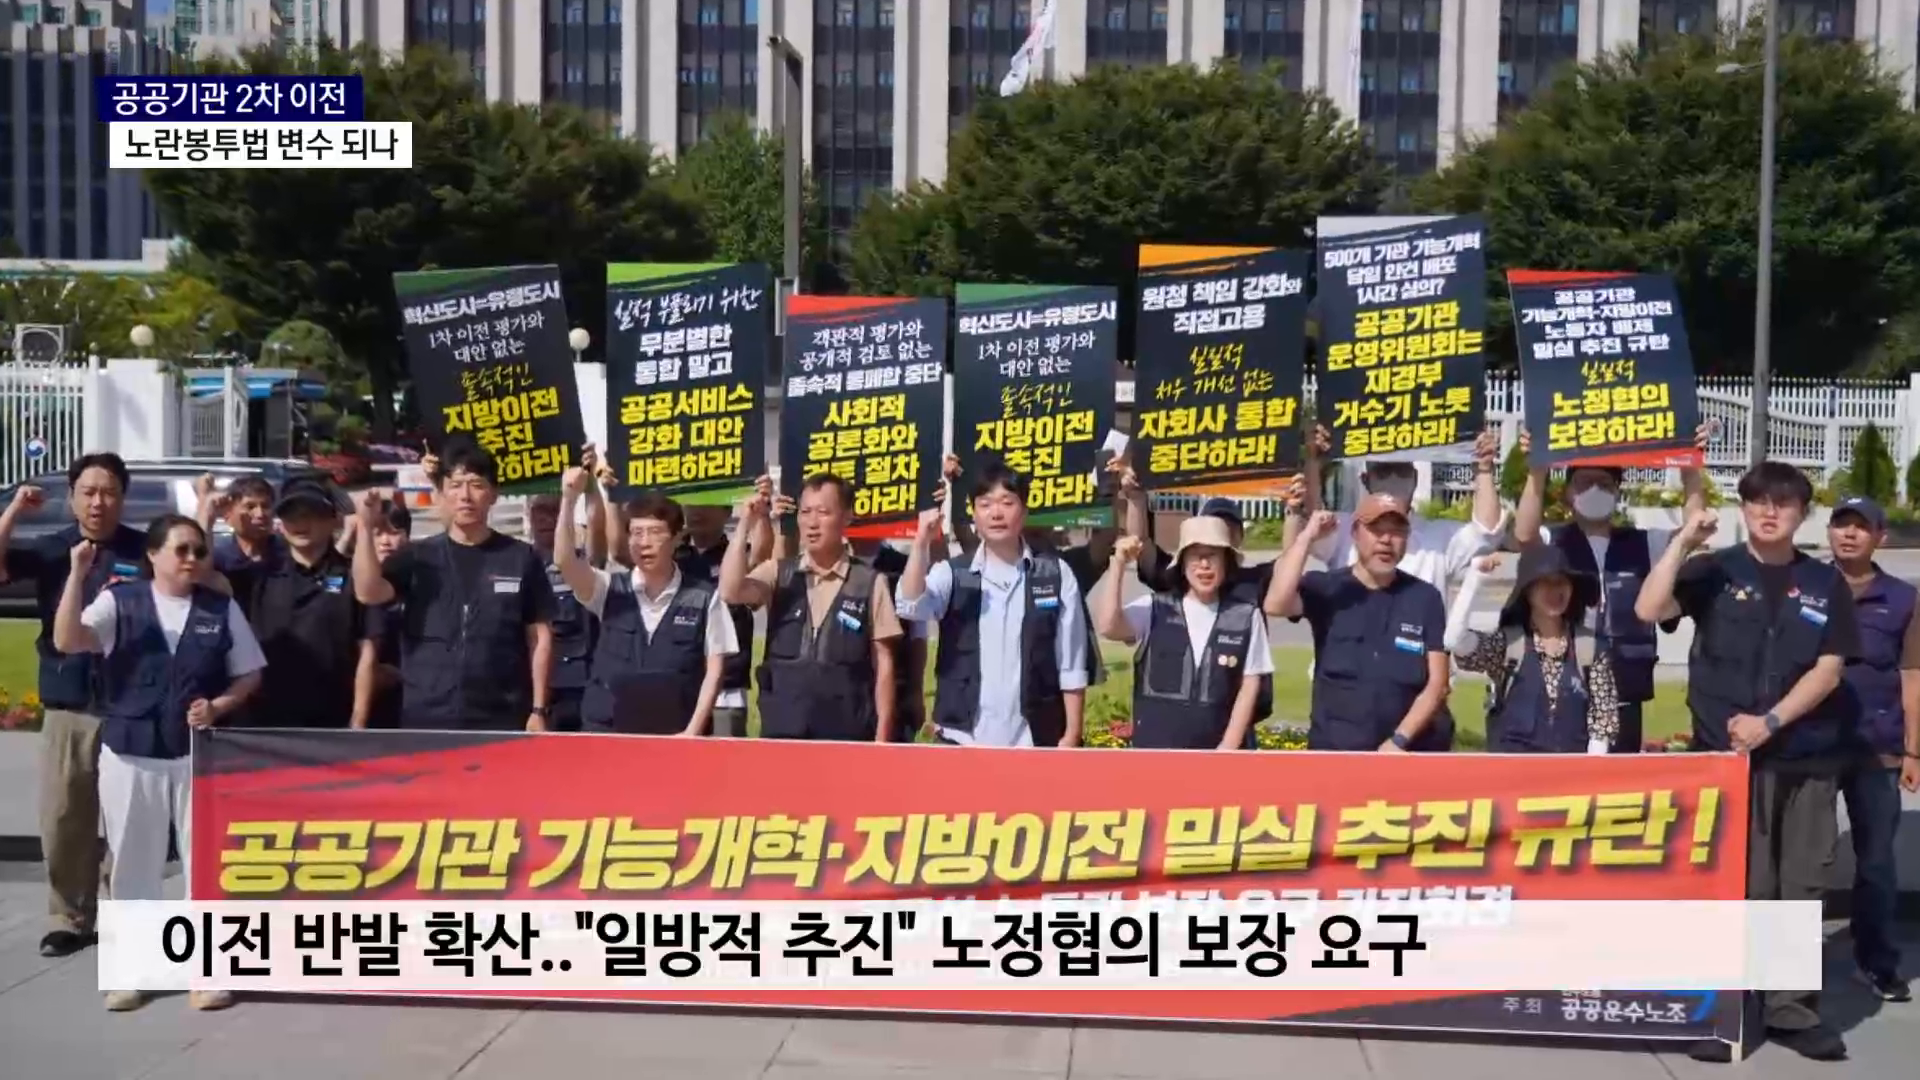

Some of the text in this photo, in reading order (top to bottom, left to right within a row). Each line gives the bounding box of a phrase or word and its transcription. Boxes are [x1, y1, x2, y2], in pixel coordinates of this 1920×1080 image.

[1324, 231, 1481, 269] 500개 기관 기능개혁
[1385, 260, 1418, 280] 안건
[1422, 254, 1457, 275] 배포
[614, 284, 764, 331] 실적 부풀리기 위한
[1142, 272, 1303, 311] 원청 책임 강화와
[1356, 278, 1446, 305] 1시간 심의?
[1554, 286, 1636, 305] 공공기관
[429, 310, 546, 349] 1차 이전 평가와
[812, 318, 925, 349] 객관적 평가와
[1173, 303, 1266, 335] 직접고용
[1354, 300, 1460, 339] 공공기관
[1544, 317, 1655, 340] 노동자 배제
[454, 339, 526, 363] 대안 없는
[640, 323, 733, 358] 무분별한
[799, 340, 934, 372] 공개적 검토 없는
[978, 330, 1097, 360] 1차 이전 평가와
[1327, 328, 1483, 371] 운영위원회는
[1533, 332, 1671, 360] 밀실 추진 규탄
[635, 350, 733, 386] 통합 말고
[1000, 355, 1072, 379] 대안 없는
[1189, 343, 1244, 376] 실질적
[1581, 359, 1637, 386] 실질적
[787, 361, 943, 398] 졸속적 통폐합 중단
[1155, 368, 1274, 402] 처우 개선 없는
[1364, 360, 1444, 395] 재경부
[442, 386, 561, 434] 지방이전
[620, 382, 754, 425] 공공서비스
[823, 394, 906, 428] 사회적
[1332, 387, 1472, 428] 거수기 노릇
[1553, 383, 1671, 418] 노정협의
[628, 415, 745, 455] 강화 대안
[974, 410, 1095, 452] 지방이전
[1137, 397, 1297, 440] 자회사 통합
[1548, 411, 1676, 450] 보장하라!
[476, 421, 535, 454] 추진
[808, 423, 919, 461] 공론화와
[1150, 435, 1277, 473] 중단하라!
[1344, 418, 1456, 457] 중단하라!
[496, 444, 570, 483] 하라!
[628, 448, 743, 487] 마련하라!
[865, 452, 920, 485] 절차
[219, 818, 521, 894] 공공기관
[1162, 803, 1317, 873] 밀실
[1333, 796, 1493, 870] 추진
[1560, 998, 1687, 1024] 공공운수노조
